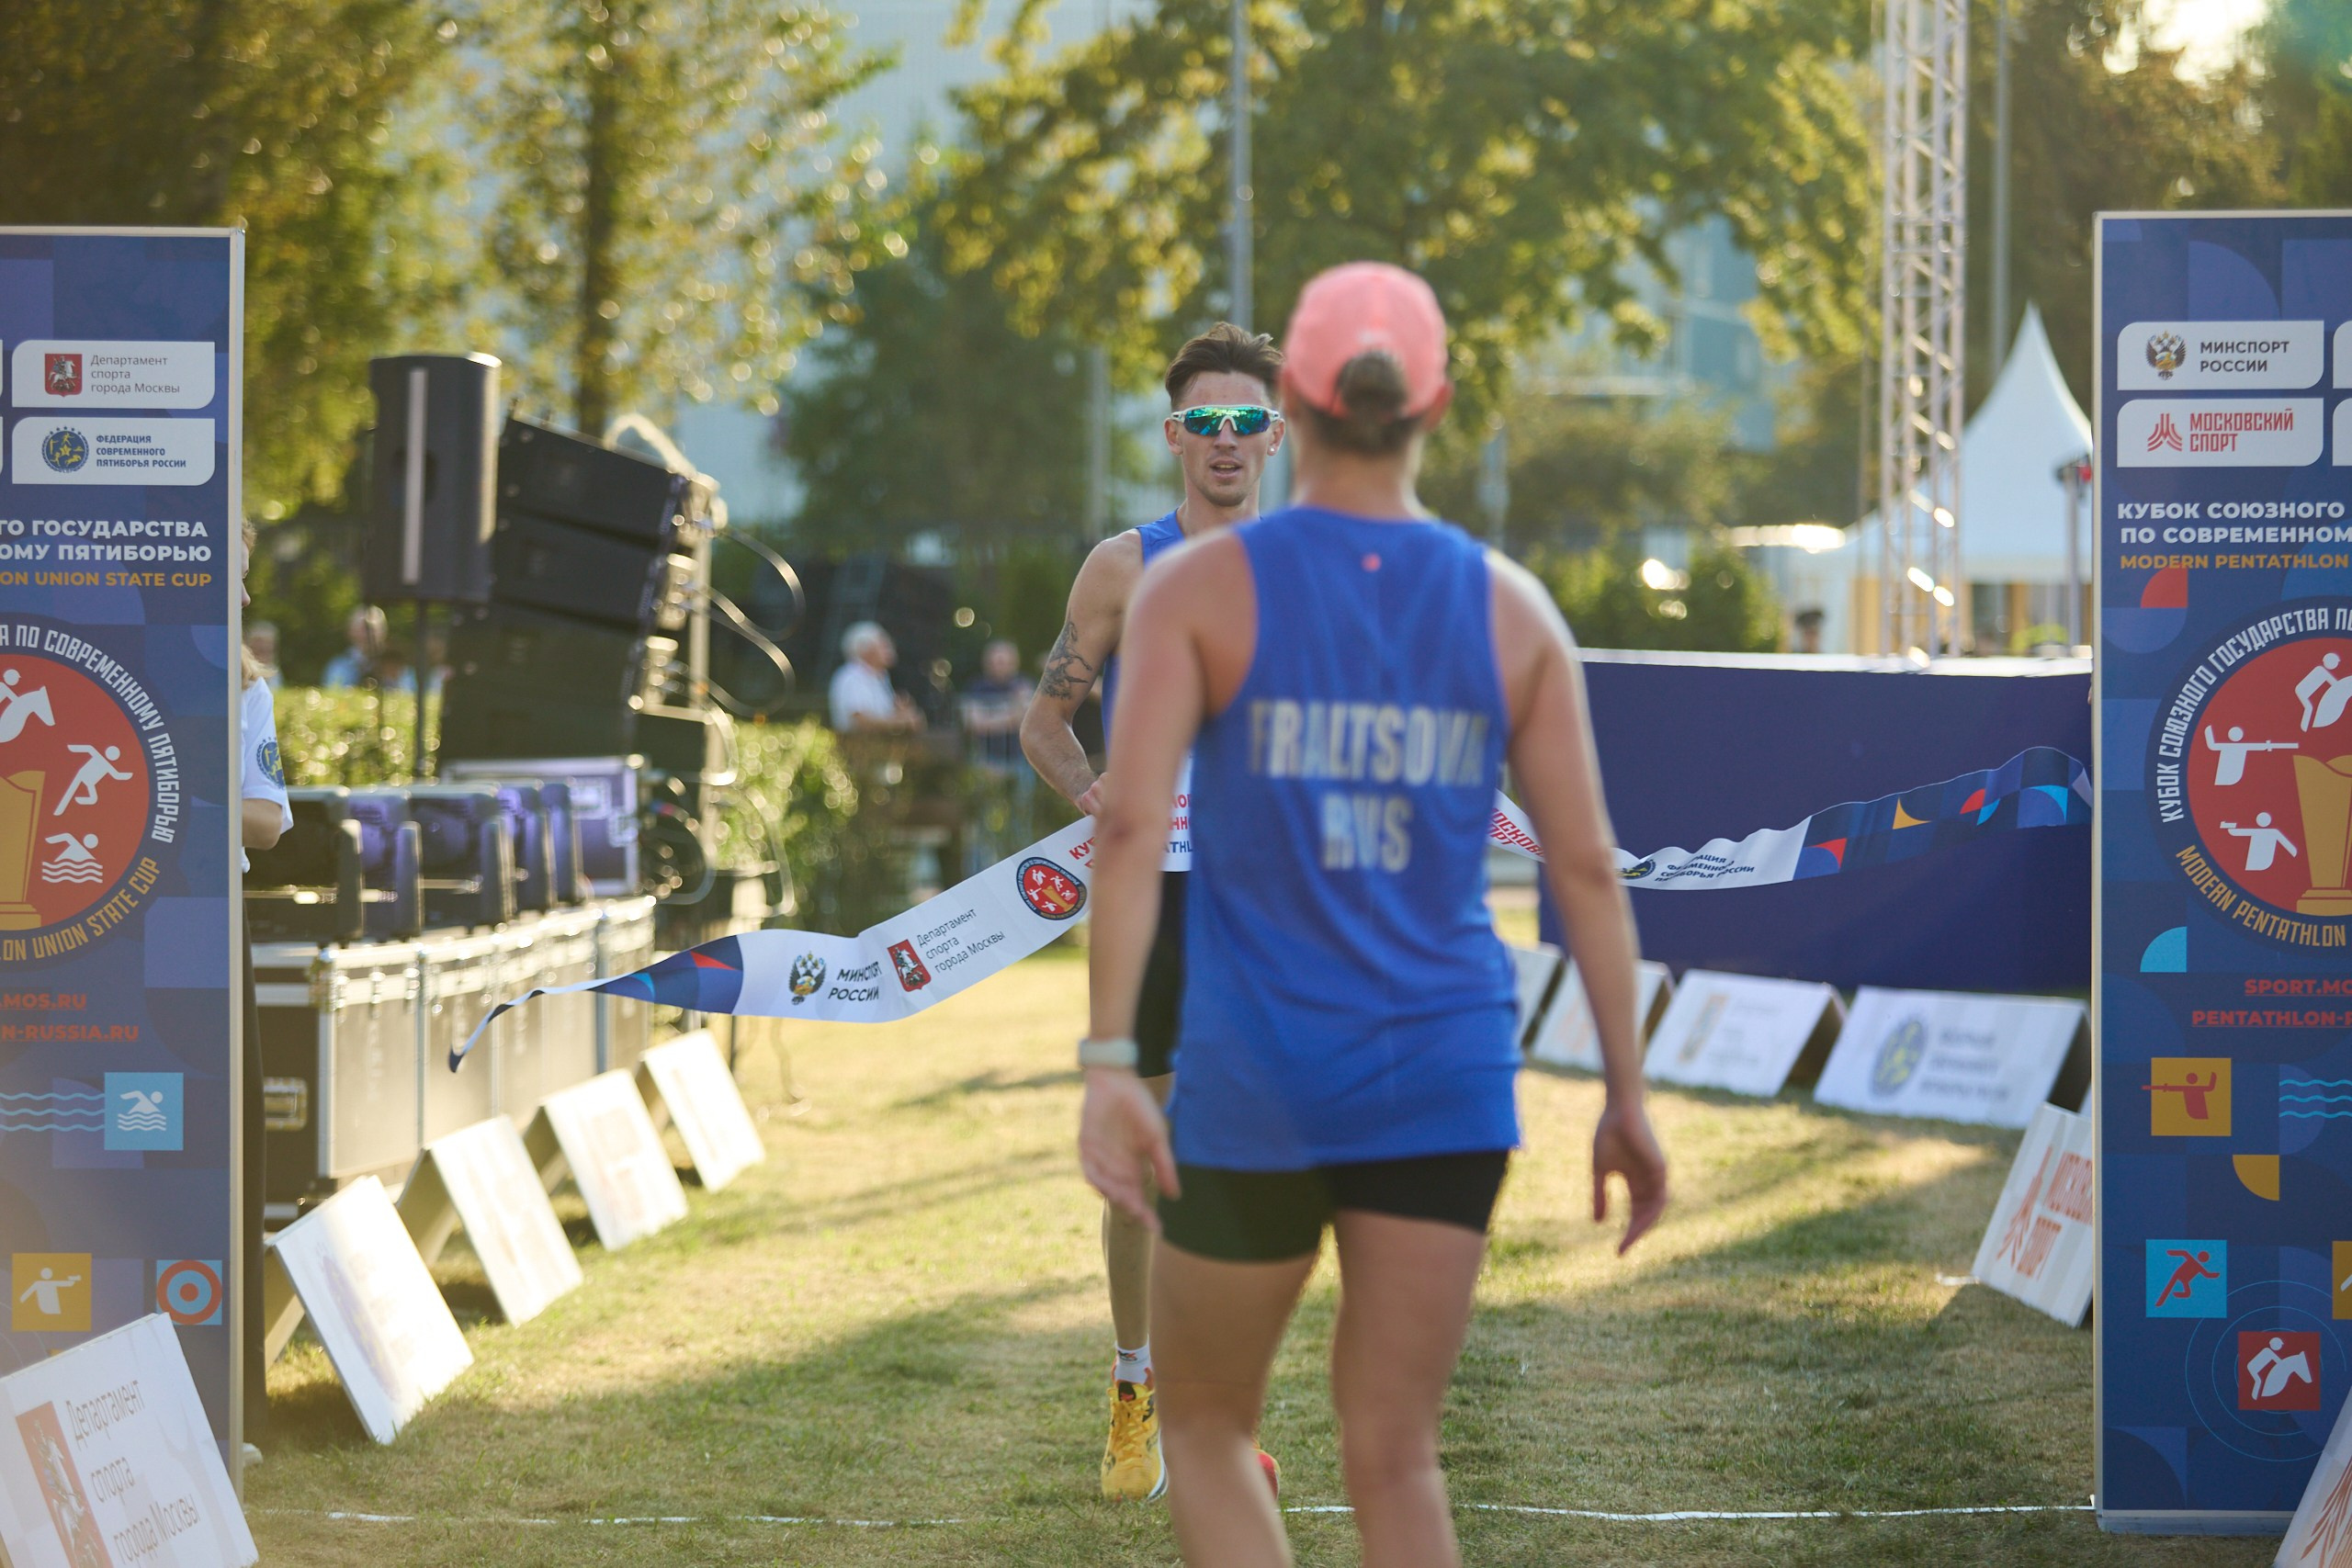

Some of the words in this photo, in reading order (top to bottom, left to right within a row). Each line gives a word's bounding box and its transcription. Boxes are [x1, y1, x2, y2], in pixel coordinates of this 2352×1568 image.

[2199, 341, 2290, 354] МИНСПОРТ
[91, 355, 168, 367] Департамент
[2199, 359, 2267, 372] РОССИИ
[91, 370, 130, 380] спорта
[91, 384, 131, 394] города
[134, 382, 180, 393] Москвы
[2190, 408, 2293, 432] МОСКОВСКИЙ
[96, 434, 152, 445] ФЕДЕРАЦИЯ
[2189, 433, 2238, 452] СПОРТ
[96, 446, 165, 457] СОВРЕМЕННОГО
[96, 458, 149, 468] ПЯТИБОРЬЯ
[152, 459, 187, 468] РОССИИ
[2117, 502, 2199, 519] КУБОК
[2207, 502, 2346, 518] СОЮЗНОГО
[32, 520, 208, 539] ГОСУДАРСТВА
[2120, 527, 2155, 544] ПО
[2163, 526, 2352, 543] СОВРЕМЕННОМ
[58, 544, 211, 562] ПЯТИБОРЬЮ
[2120, 554, 2209, 569] MODERN
[2215, 554, 2348, 569] PENTATHLON
[35, 571, 99, 586] UNION
[105, 571, 165, 587] STATE
[171, 572, 212, 588] CUP
[2207, 607, 2329, 673] ГОСУДАРСТВА
[2158, 664, 2218, 759] СОЮЗНОГО
[16, 625, 40, 649] ПО
[43, 629, 164, 731] СОВРЕМЕННОМУ
[147, 732, 180, 844] ПЯТИБОРЬЮ
[2156, 762, 2185, 823] КУБОК
[2176, 844, 2237, 912] MODERN
[2232, 900, 2346, 947] PENTATHLON
[0, 939, 28, 961] ON
[32, 923, 89, 959] UNION
[86, 888, 140, 937] STATE
[128, 856, 161, 896] CUP
[916, 908, 978, 949] Департамент
[926, 936, 960, 963] спорта
[934, 952, 968, 975] города
[967, 931, 1006, 956] Москвы
[836, 961, 883, 983] МИНСПОРТ
[828, 986, 879, 1002] РОССИИ
[2, 1024, 140, 1041] N-RUSSIA.RU
[65, 1380, 145, 1451] Департамент
[89, 1456, 135, 1506] спорта
[112, 1516, 159, 1565] города
[150, 1495, 201, 1541] Москвы
